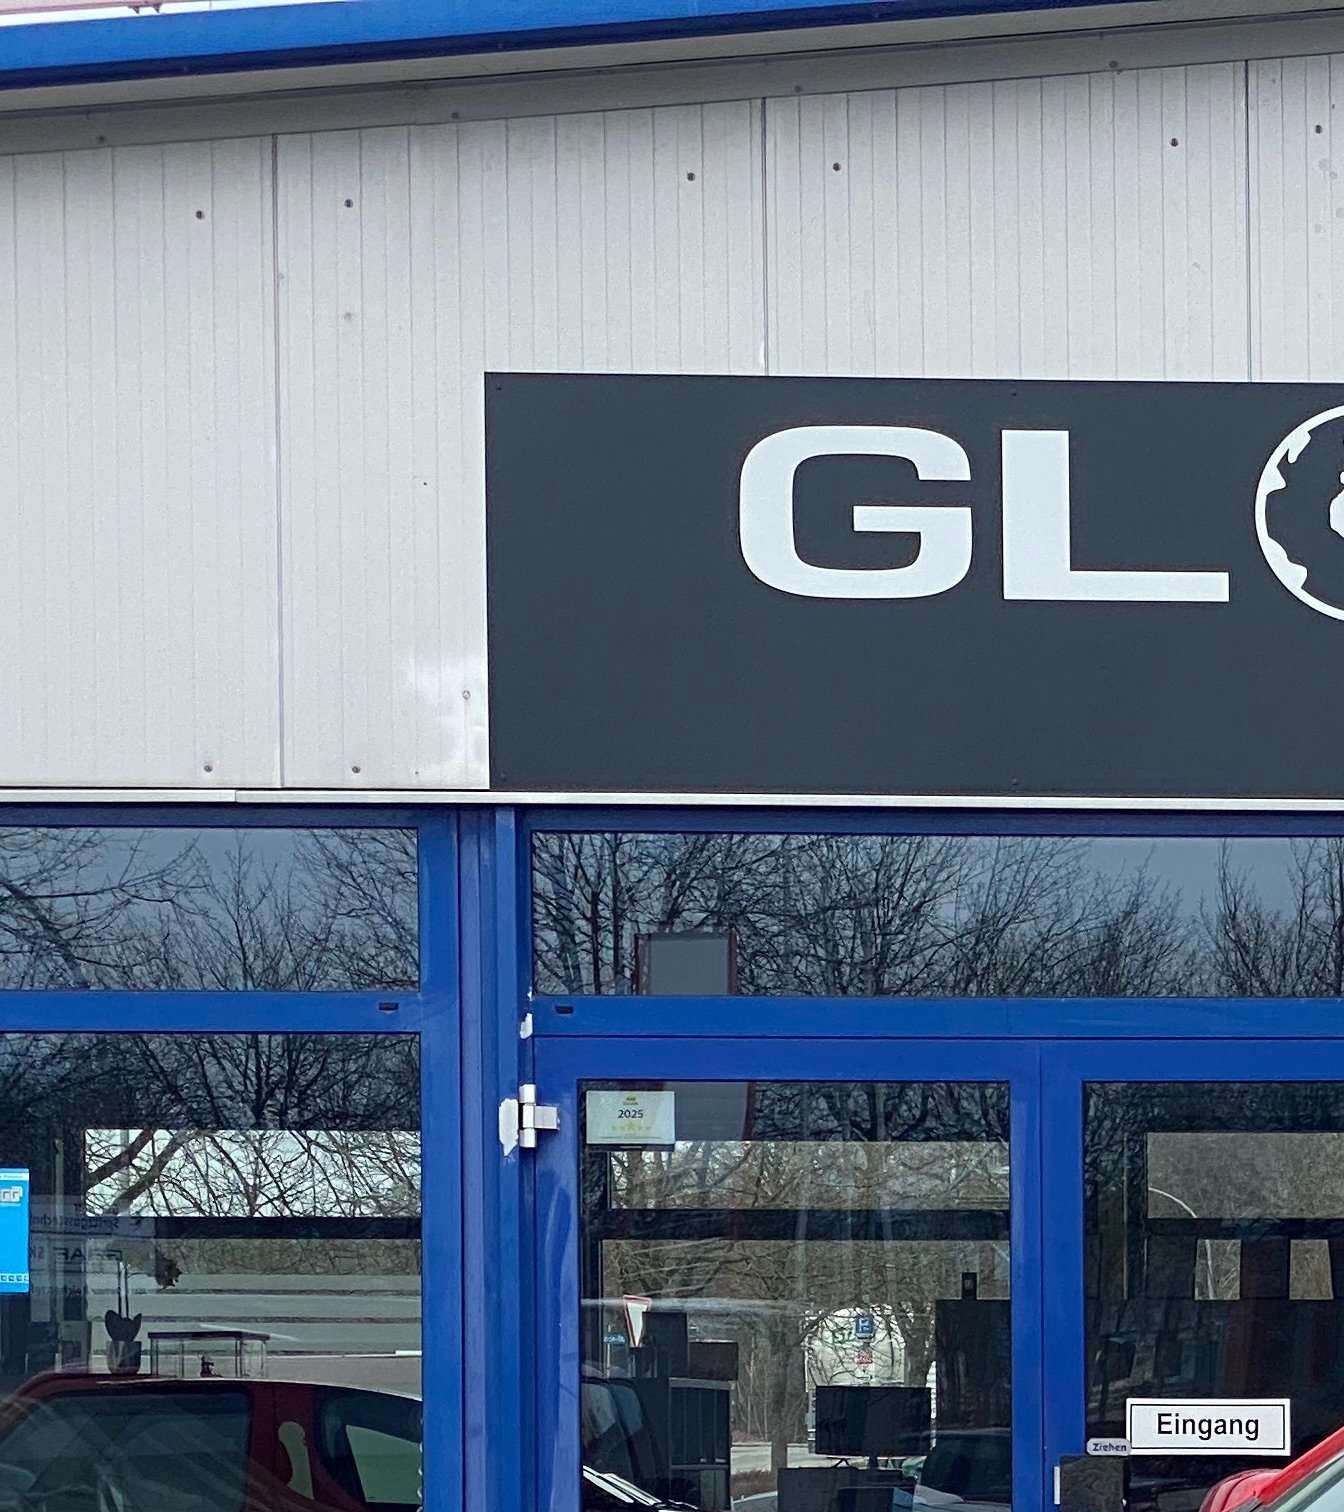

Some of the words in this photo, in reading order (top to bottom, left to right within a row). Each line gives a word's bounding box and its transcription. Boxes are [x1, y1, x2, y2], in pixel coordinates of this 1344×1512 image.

[617, 1109, 644, 1119] 2025
[1157, 1412, 1260, 1441] Eingang
[1092, 1443, 1127, 1452] Ziehen
